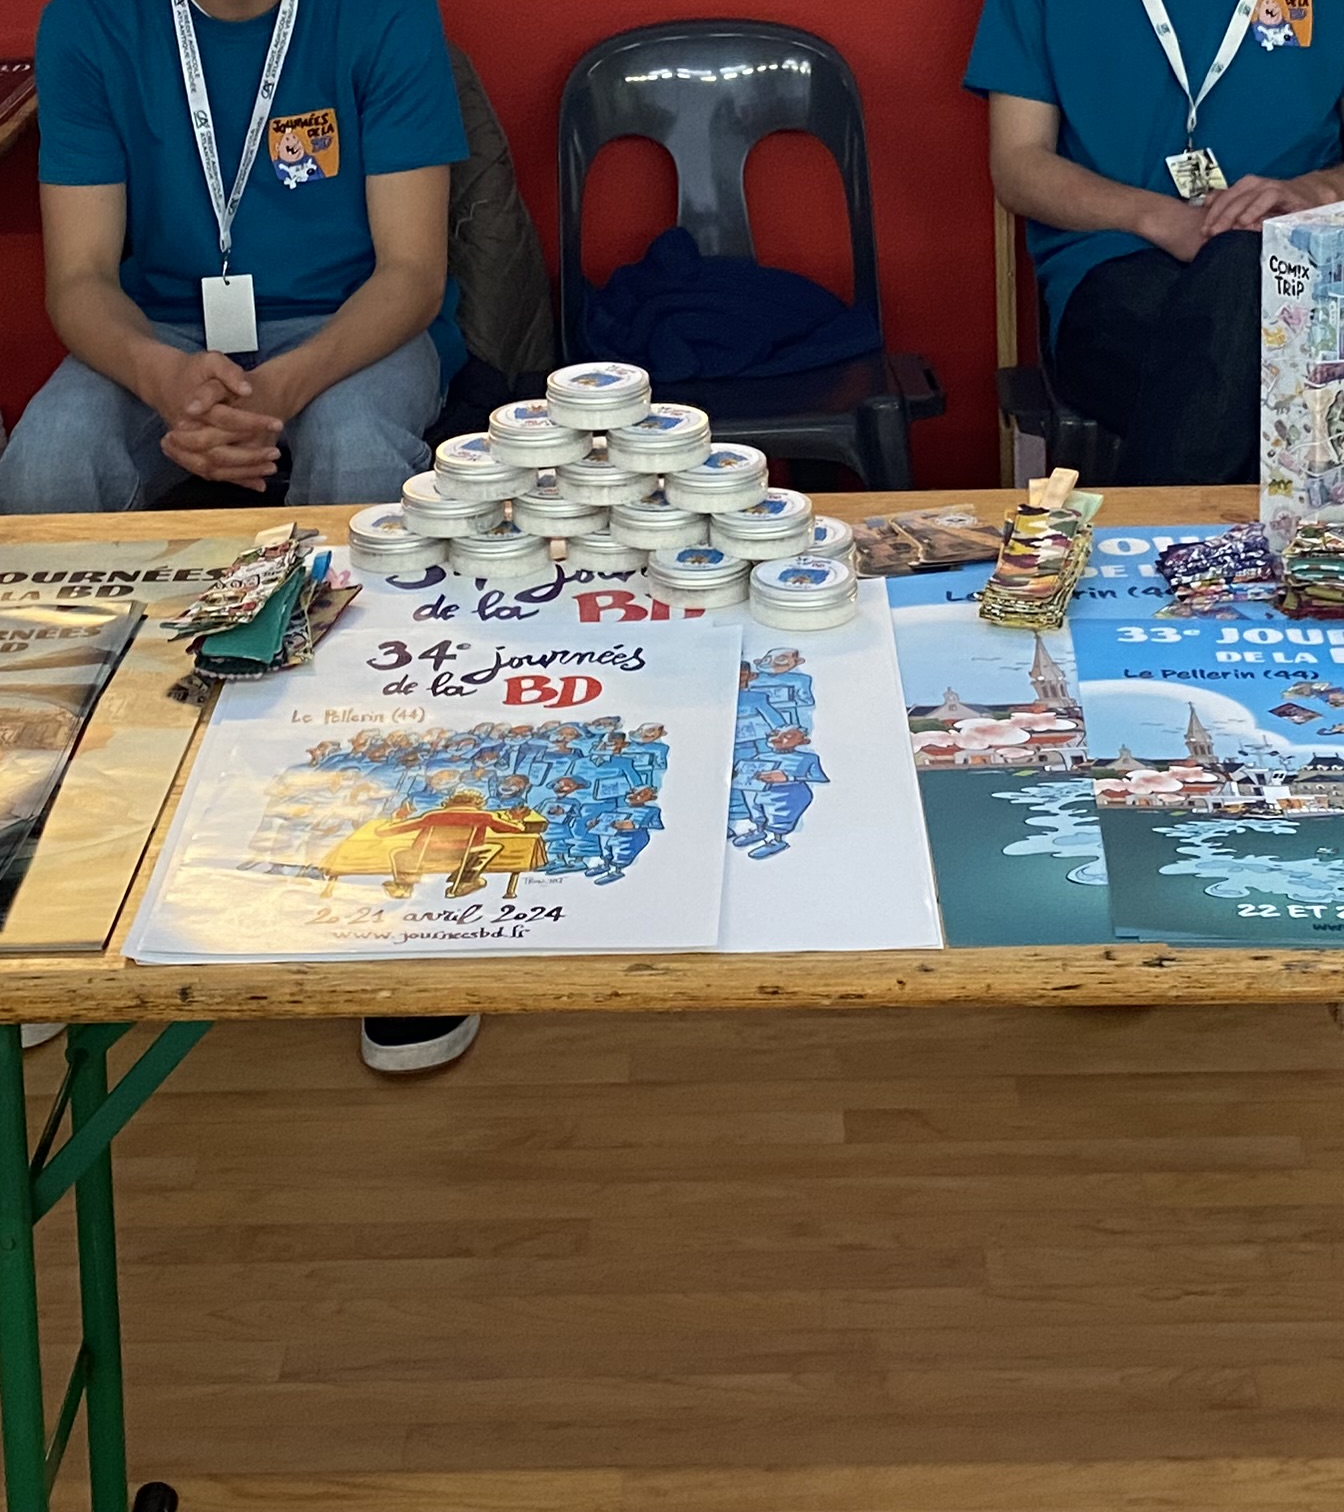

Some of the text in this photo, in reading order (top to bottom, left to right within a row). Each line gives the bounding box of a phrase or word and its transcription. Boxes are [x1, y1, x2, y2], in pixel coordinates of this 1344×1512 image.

[1, 589, 40, 603] LA
[56, 584, 135, 600] BD
[413, 590, 540, 622] de la
[462, 644, 647, 685] journées
[1216, 649, 1268, 665] DE
[1274, 649, 1320, 665] LA
[1123, 666, 1320, 683] Le Pellerin (44)
[383, 671, 604, 710] de la BD
[392, 706, 427, 725] (44)
[402, 903, 567, 925] avril 2024
[1236, 903, 1281, 918] 22
[1287, 904, 1328, 919] ET
